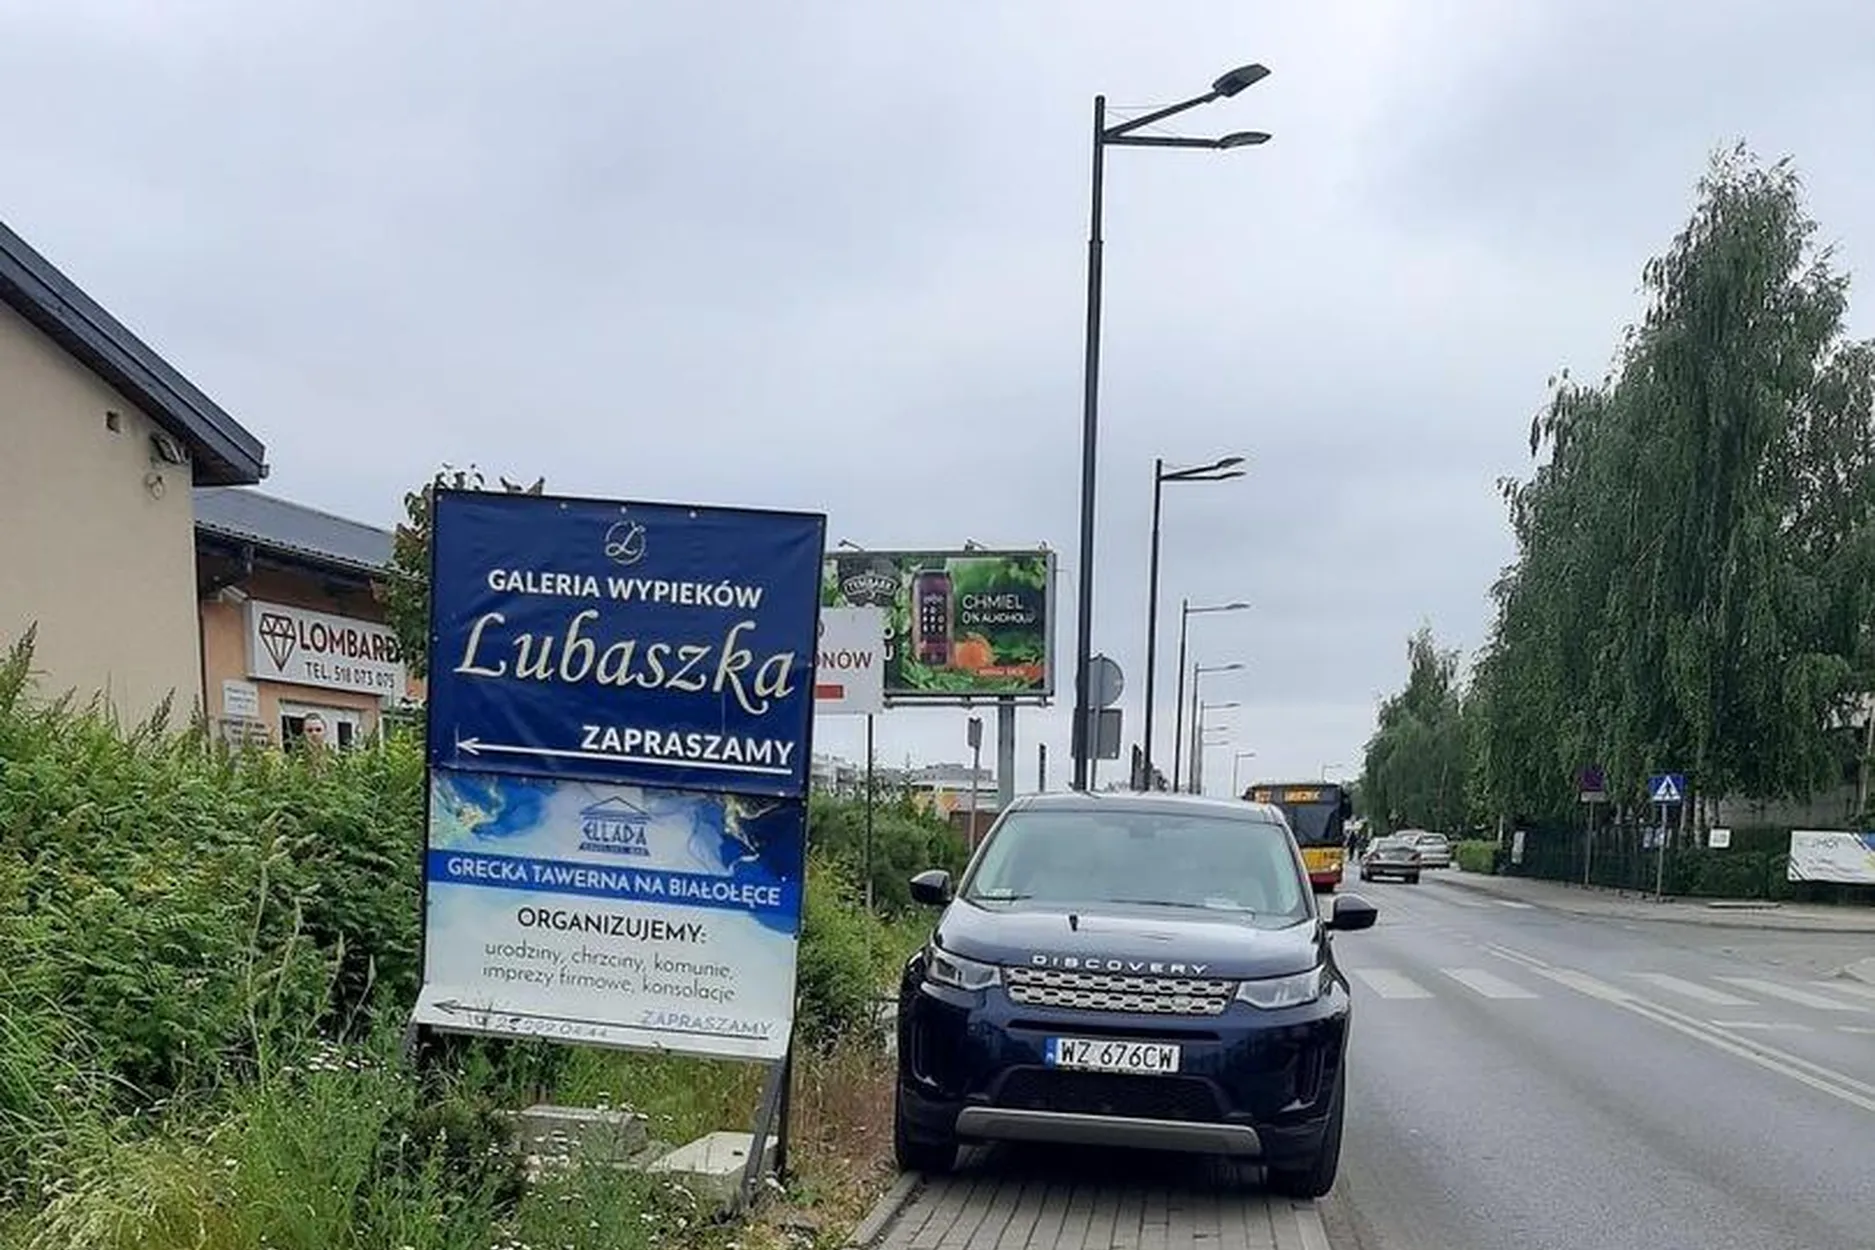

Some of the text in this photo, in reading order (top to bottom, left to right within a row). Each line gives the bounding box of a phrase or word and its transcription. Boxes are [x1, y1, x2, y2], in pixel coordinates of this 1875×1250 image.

[488, 569, 763, 609] GALERIA WYPIEKÓW
[963, 594, 1024, 610] CHMIEL
[454, 609, 796, 715] Lubaszka
[582, 724, 795, 766] ZAPRASZAMY
[448, 857, 781, 909] GRECKA TAWERNA NA BIAŁOŁĘCE
[517, 907, 707, 943] ORGANIZUJEMY:
[485, 940, 734, 979] urodziny, chrzciny, komunie,
[1032, 955, 1208, 974] DISCOVERY
[483, 965, 735, 1003] imprezy firmowe, konsolacje
[643, 1010, 773, 1034] ZAPRASZAMY
[1062, 1041, 1092, 1064] WZ
[1100, 1045, 1173, 1068] 676CW
